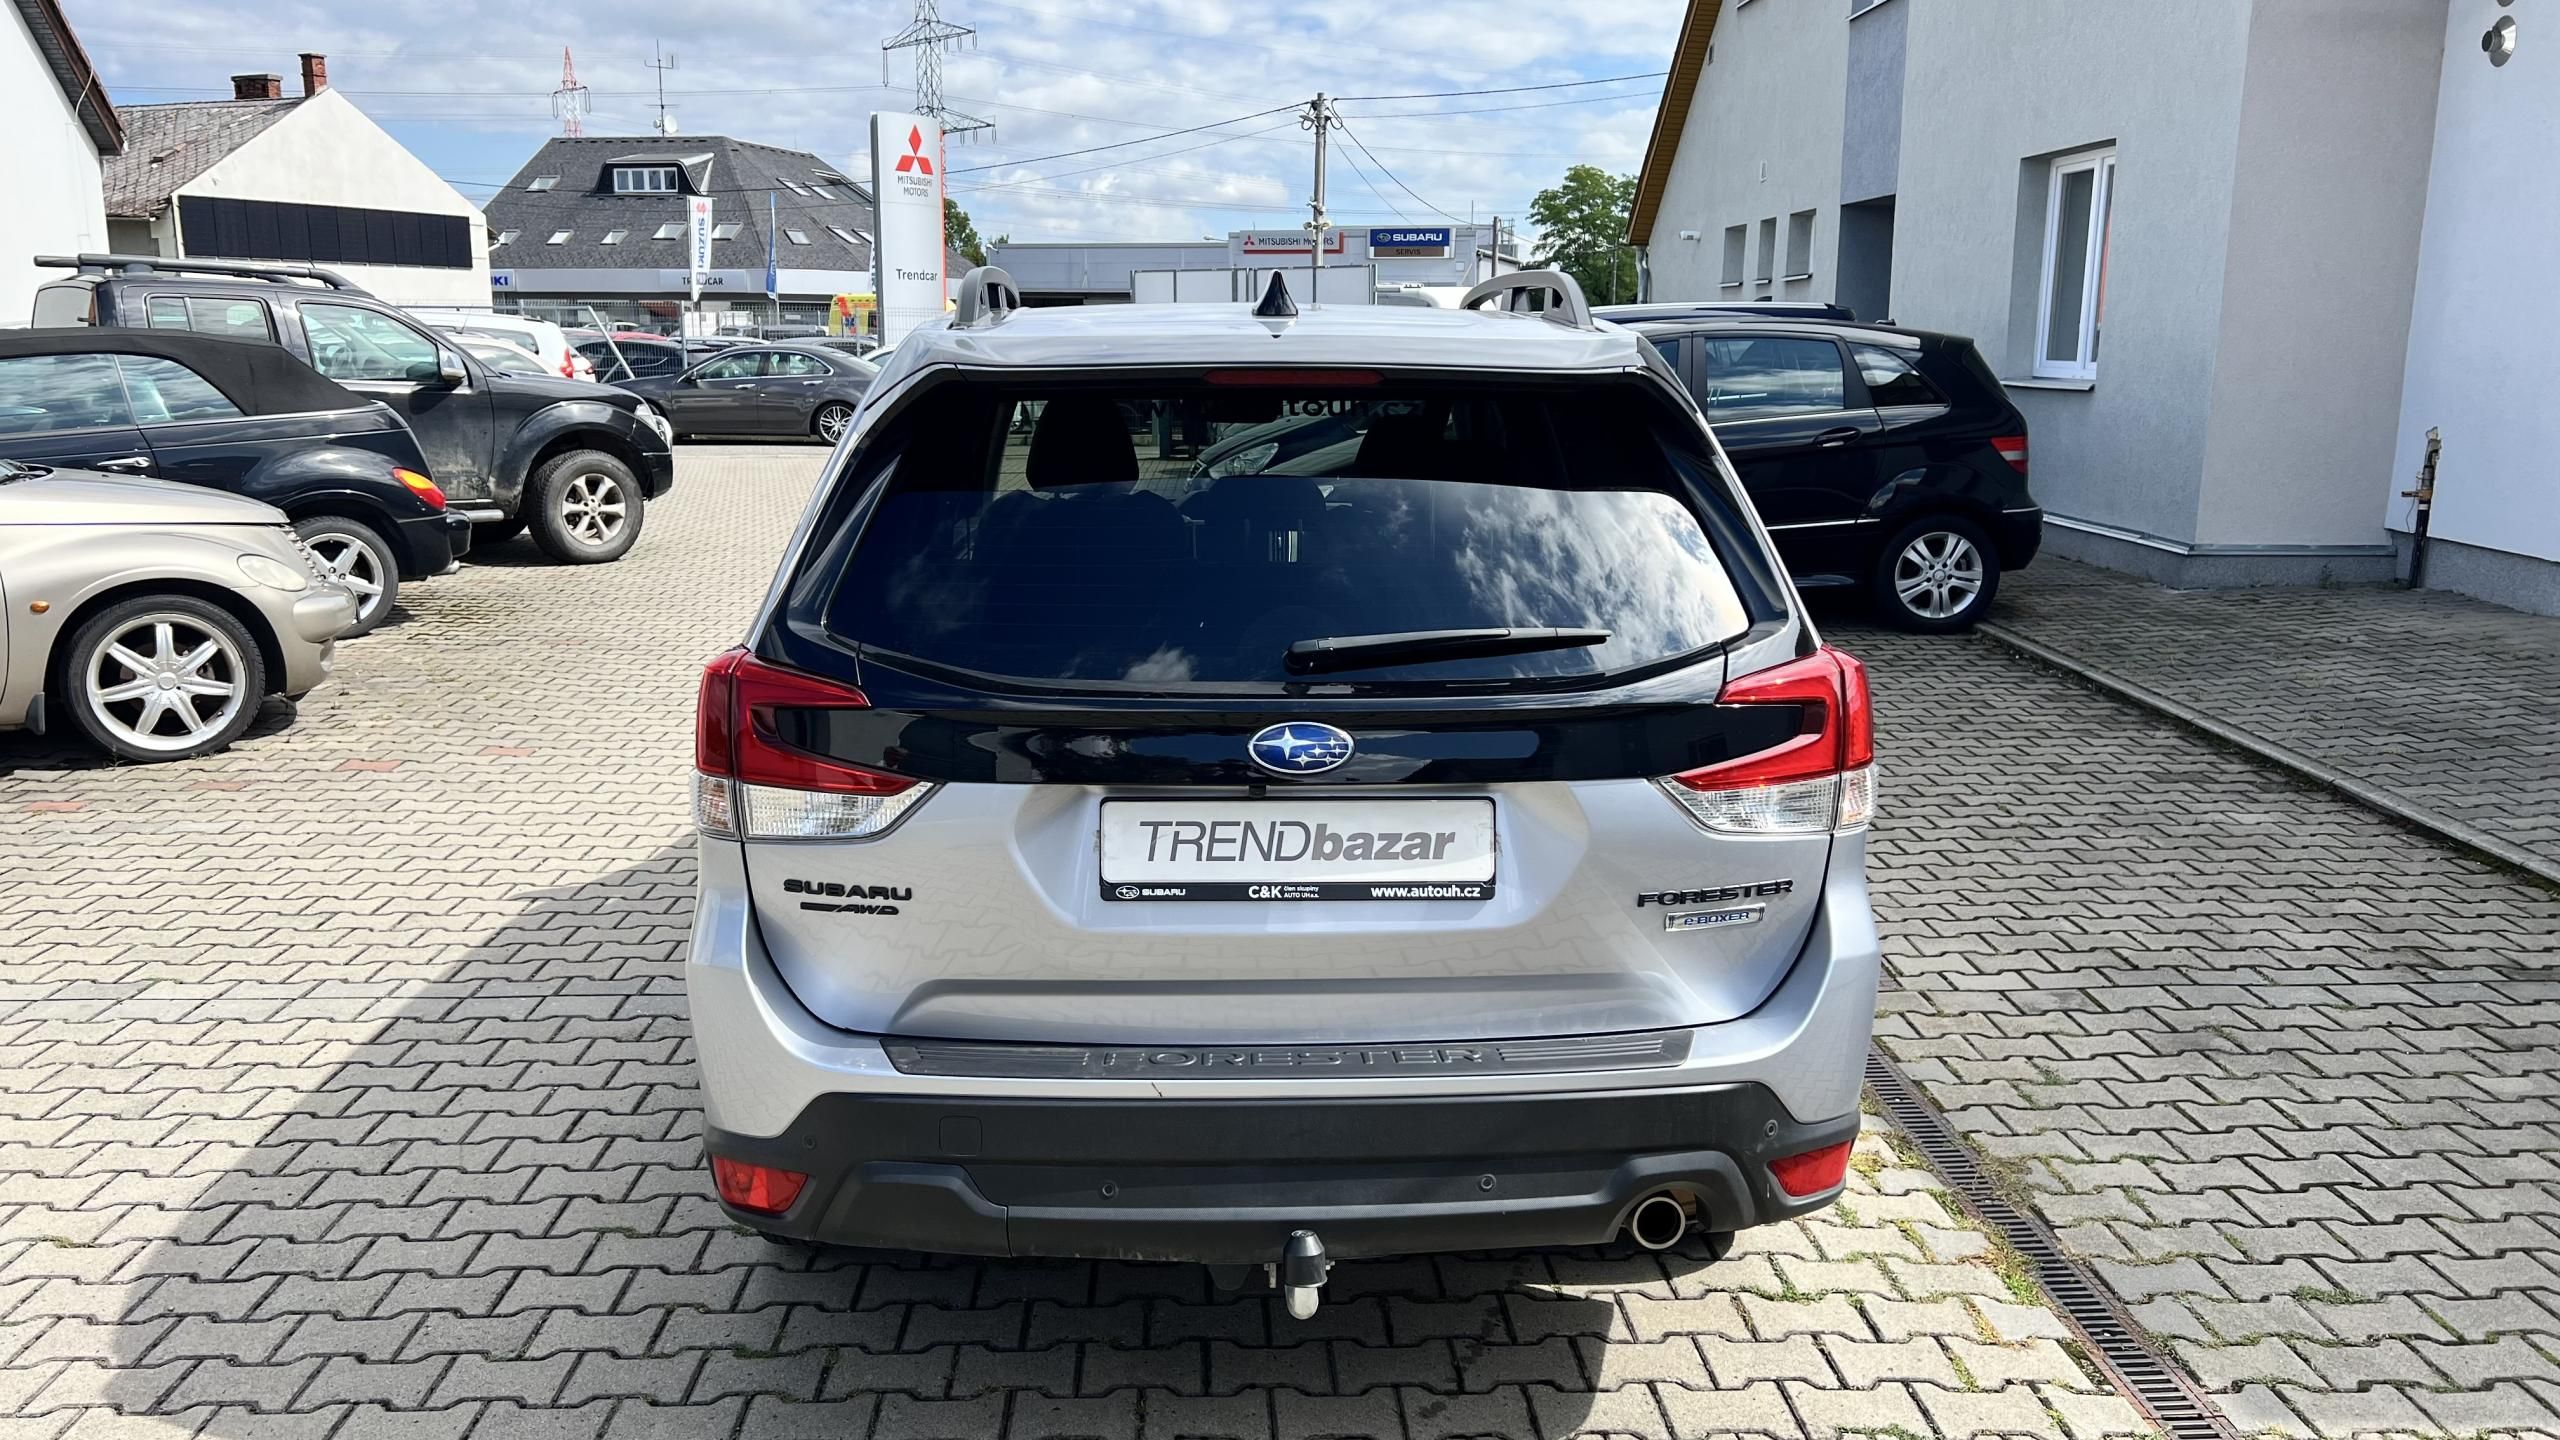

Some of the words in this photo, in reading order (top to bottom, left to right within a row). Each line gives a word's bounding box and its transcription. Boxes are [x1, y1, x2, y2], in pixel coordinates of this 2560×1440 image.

[897, 175, 933, 187] MITSUBISHI
[903, 187, 929, 198] MOTORS
[697, 217, 706, 268] SUZUKI
[1258, 237, 1301, 246] MITSUBISHI
[1392, 233, 1443, 242] SUBARU
[896, 268, 938, 281] Trendcar
[1139, 820, 1456, 862] TRENDbazar
[783, 878, 913, 901] SUBARU
[1141, 888, 1186, 896] SUBARU
[1248, 885, 1282, 899] C&K
[1370, 884, 1481, 898] www.autouh.cz
[1637, 878, 1794, 908] FORESTER
[835, 903, 900, 916] AWD
[1102, 1047, 1482, 1069] FORESTER
